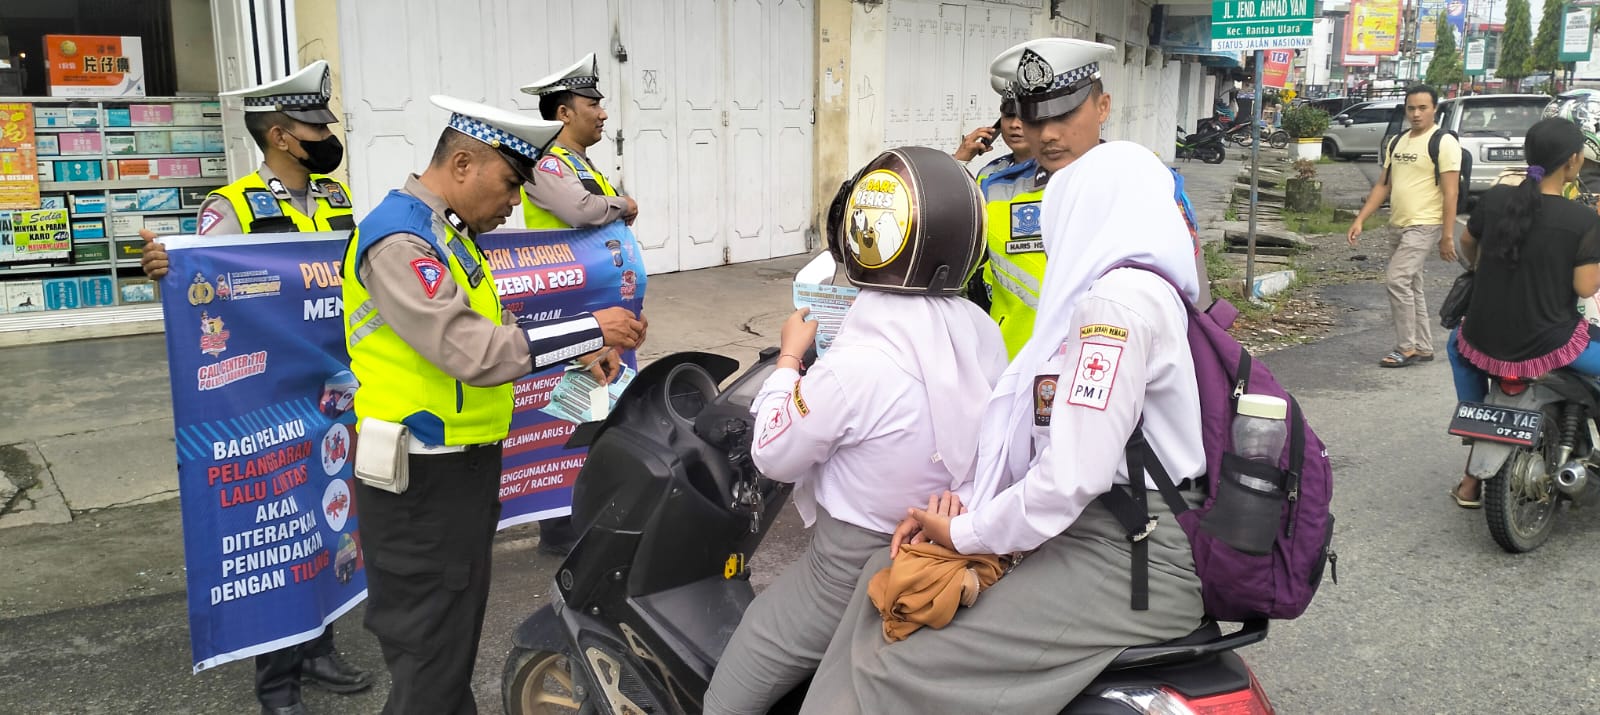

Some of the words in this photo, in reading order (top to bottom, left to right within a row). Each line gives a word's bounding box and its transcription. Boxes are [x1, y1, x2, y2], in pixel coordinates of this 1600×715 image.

[1236, 1, 1257, 18] JEND.
[1260, 0, 1288, 17] AHMAD
[1290, 0, 1307, 16] YANI
[1226, 26, 1242, 36] Kec.
[1246, 25, 1275, 35] Rantau
[1277, 24, 1301, 34] Utara
[1217, 40, 1243, 50] STATUS
[1246, 39, 1271, 49] JALAN
[866, 179, 898, 194] BARE
[14, 224, 38, 232] MINYAK
[46, 223, 67, 231] PARAM
[29, 211, 62, 223] Sedia
[29, 233, 50, 241] KARO
[484, 248, 515, 271] DAN
[514, 243, 576, 268] JAJARAN
[495, 273, 546, 295] ZEBRA
[547, 268, 584, 289] 2023
[199, 363, 220, 380] CALL
[221, 354, 249, 374] CENTER
[250, 351, 266, 365] 110
[532, 376, 563, 391] MENGG
[514, 393, 544, 408] SAFETY
[1513, 412, 1539, 428] YAE
[213, 435, 258, 461] BAGI
[256, 418, 305, 450] PELAKU
[502, 434, 541, 449] MELAWAN
[541, 426, 564, 439] ARUS
[565, 424, 577, 435] LA
[207, 440, 313, 486] PELANGGARAN
[500, 462, 560, 485] ENGGUNAKAN
[560, 457, 587, 471] KNAL
[219, 480, 267, 508] LALU
[272, 463, 308, 496] LINTAS
[530, 473, 564, 490] RACING
[254, 495, 299, 524] AKAN
[222, 508, 316, 555] DITERAPKAN
[221, 530, 323, 578] PENINDAKAN
[210, 568, 286, 606] DENGAN
